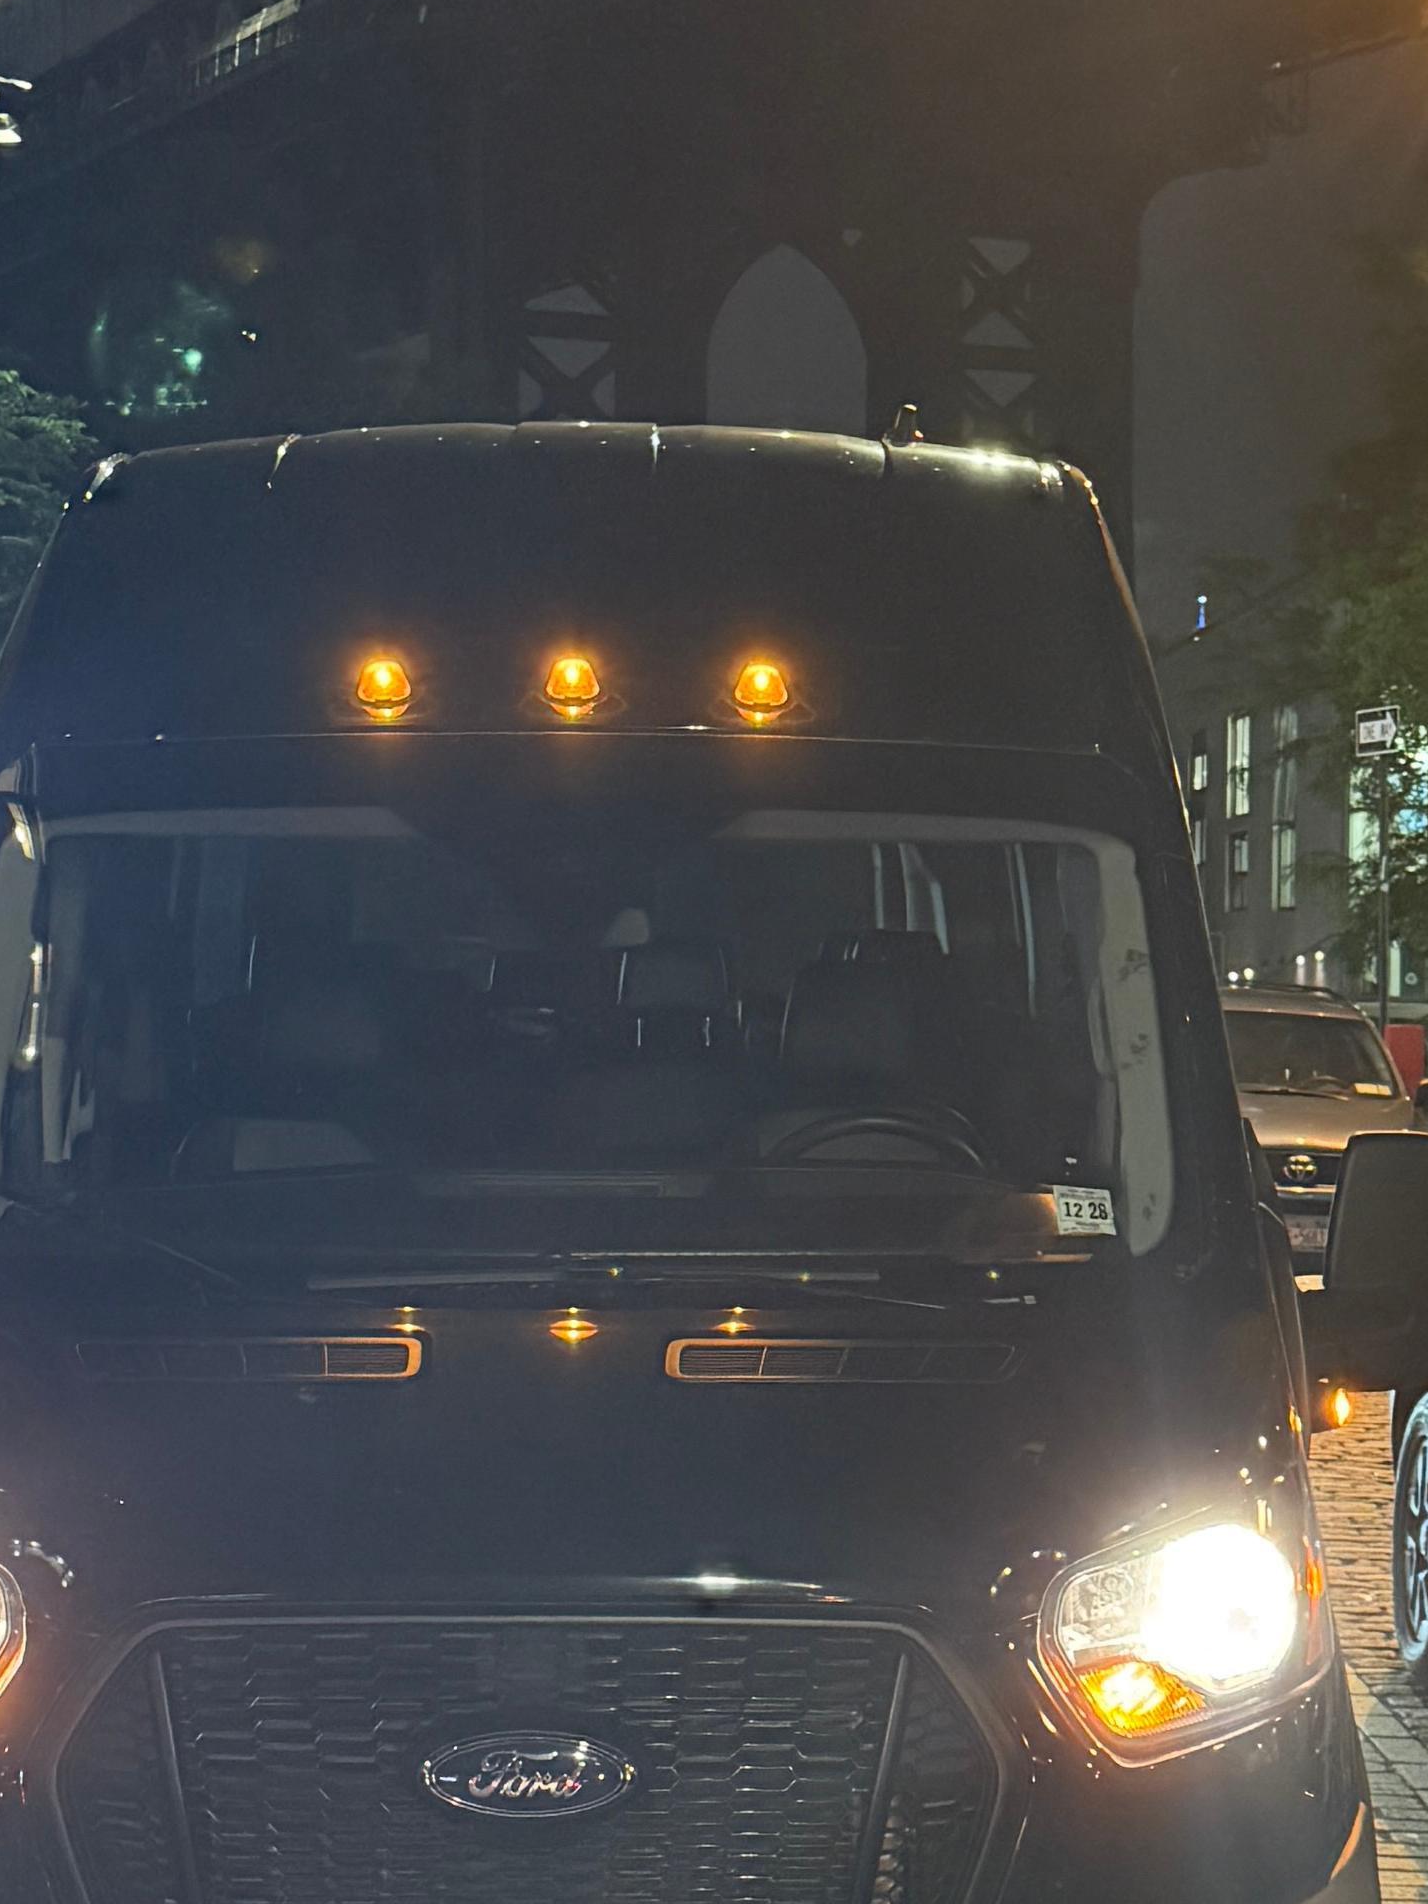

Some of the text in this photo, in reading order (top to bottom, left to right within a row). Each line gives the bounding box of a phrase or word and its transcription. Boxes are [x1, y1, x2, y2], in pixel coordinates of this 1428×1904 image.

[1064, 1202, 1108, 1220] 12 28
[468, 1750, 586, 1798] Ford
